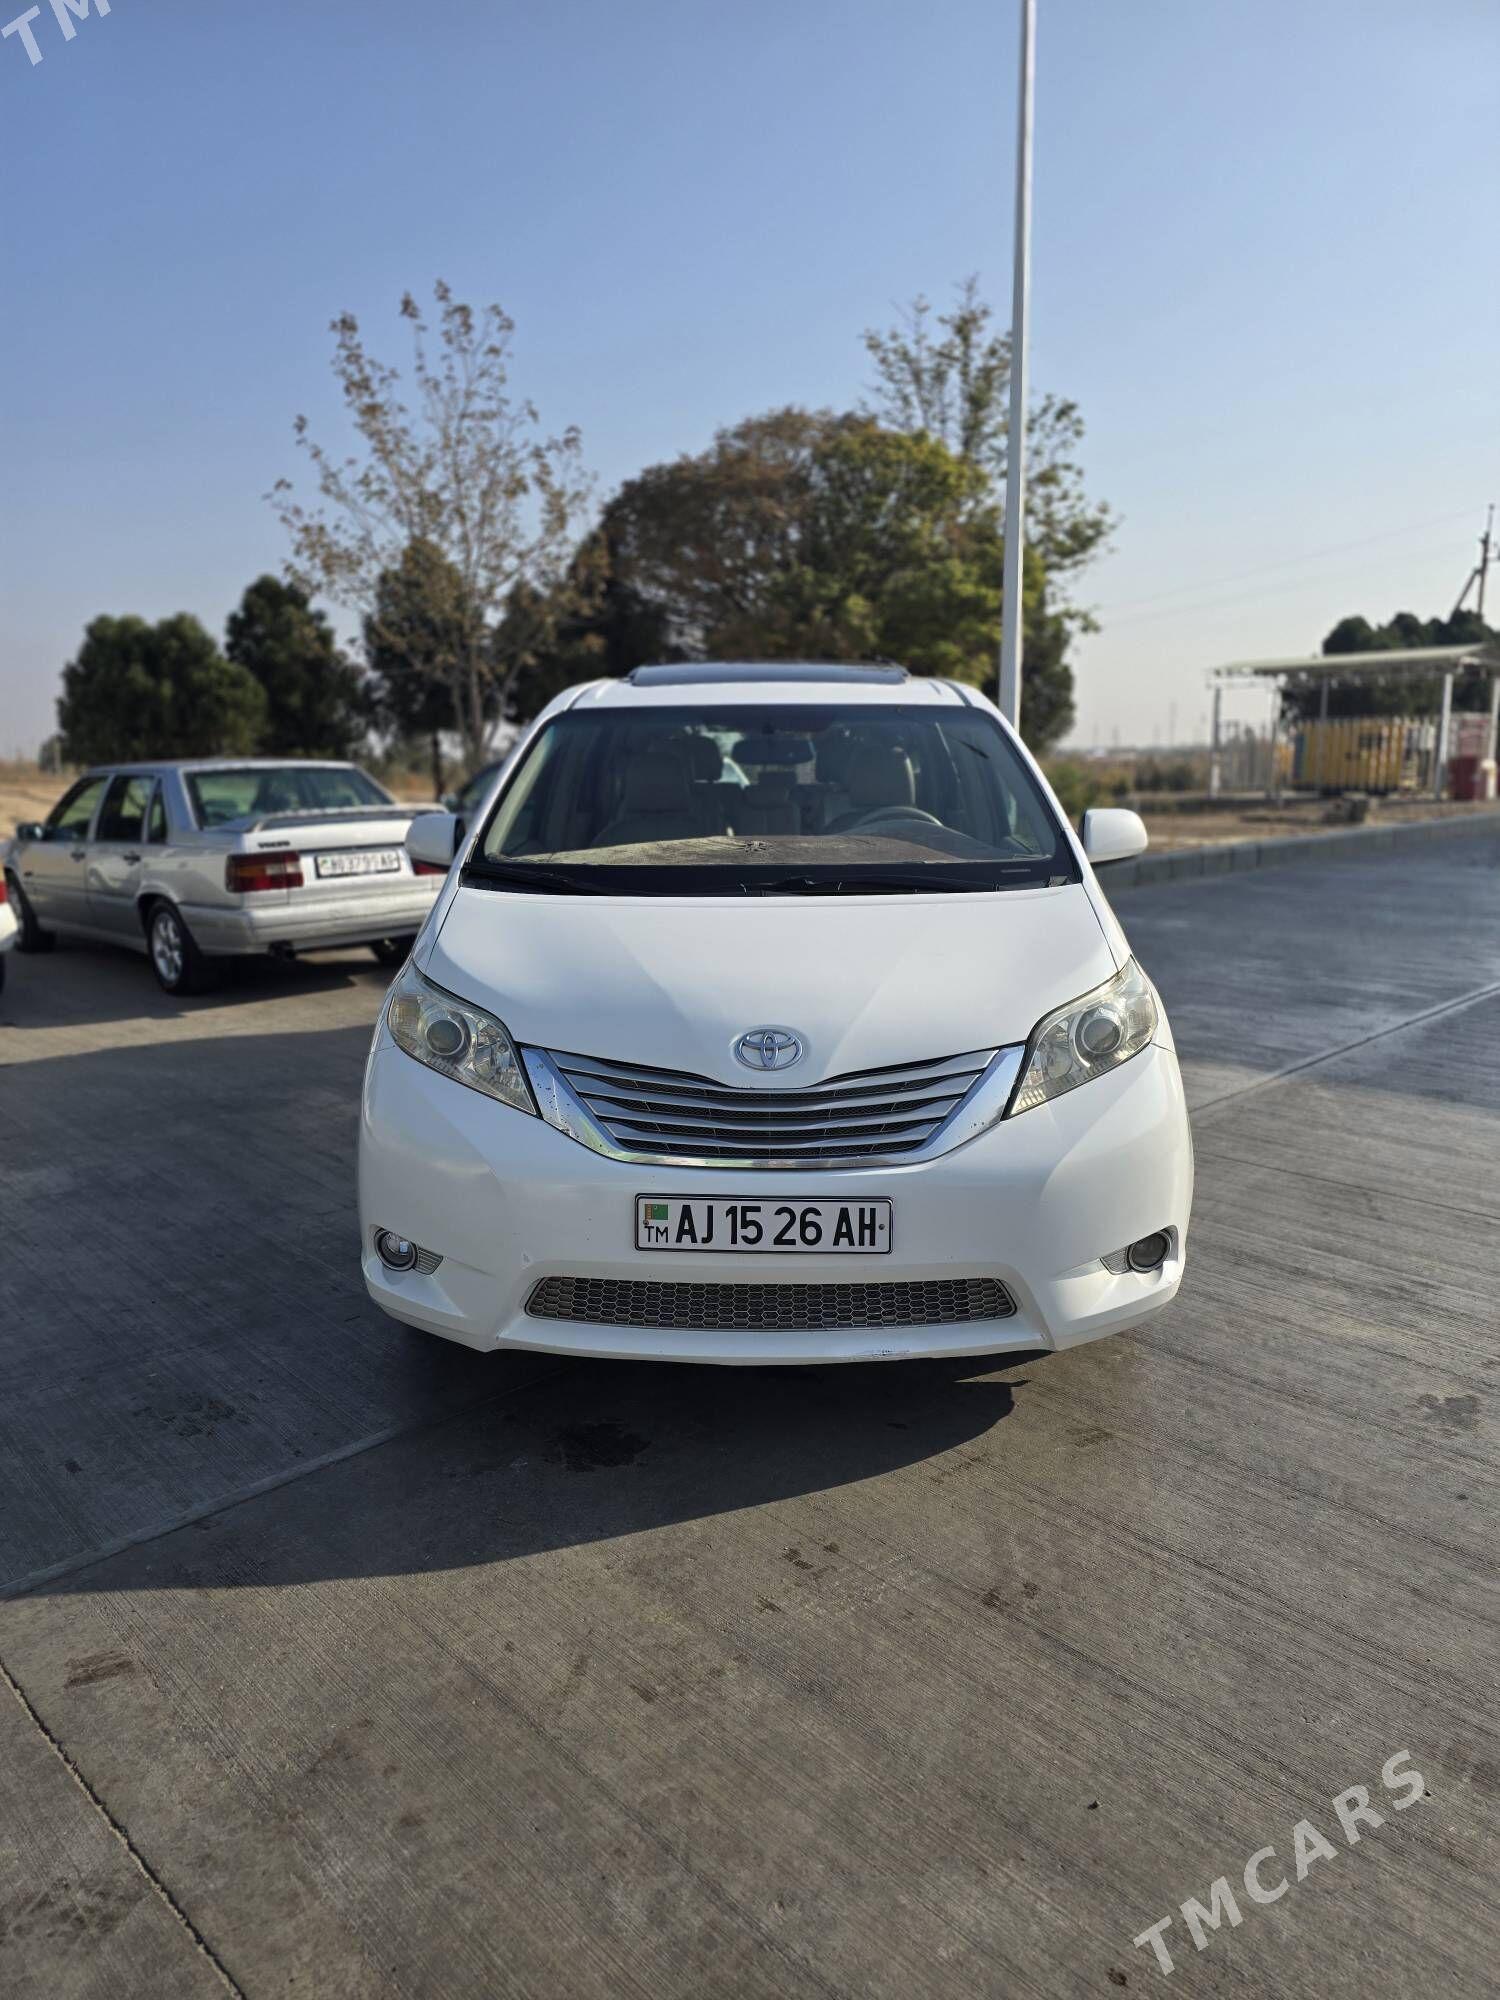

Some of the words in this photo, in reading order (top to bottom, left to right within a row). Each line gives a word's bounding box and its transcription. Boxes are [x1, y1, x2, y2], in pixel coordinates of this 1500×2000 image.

[644, 1225, 669, 1243] TM
[675, 1204, 714, 1244] AJ
[725, 1205, 764, 1245] 15
[773, 1206, 823, 1246] 26
[832, 1207, 877, 1247] AH
